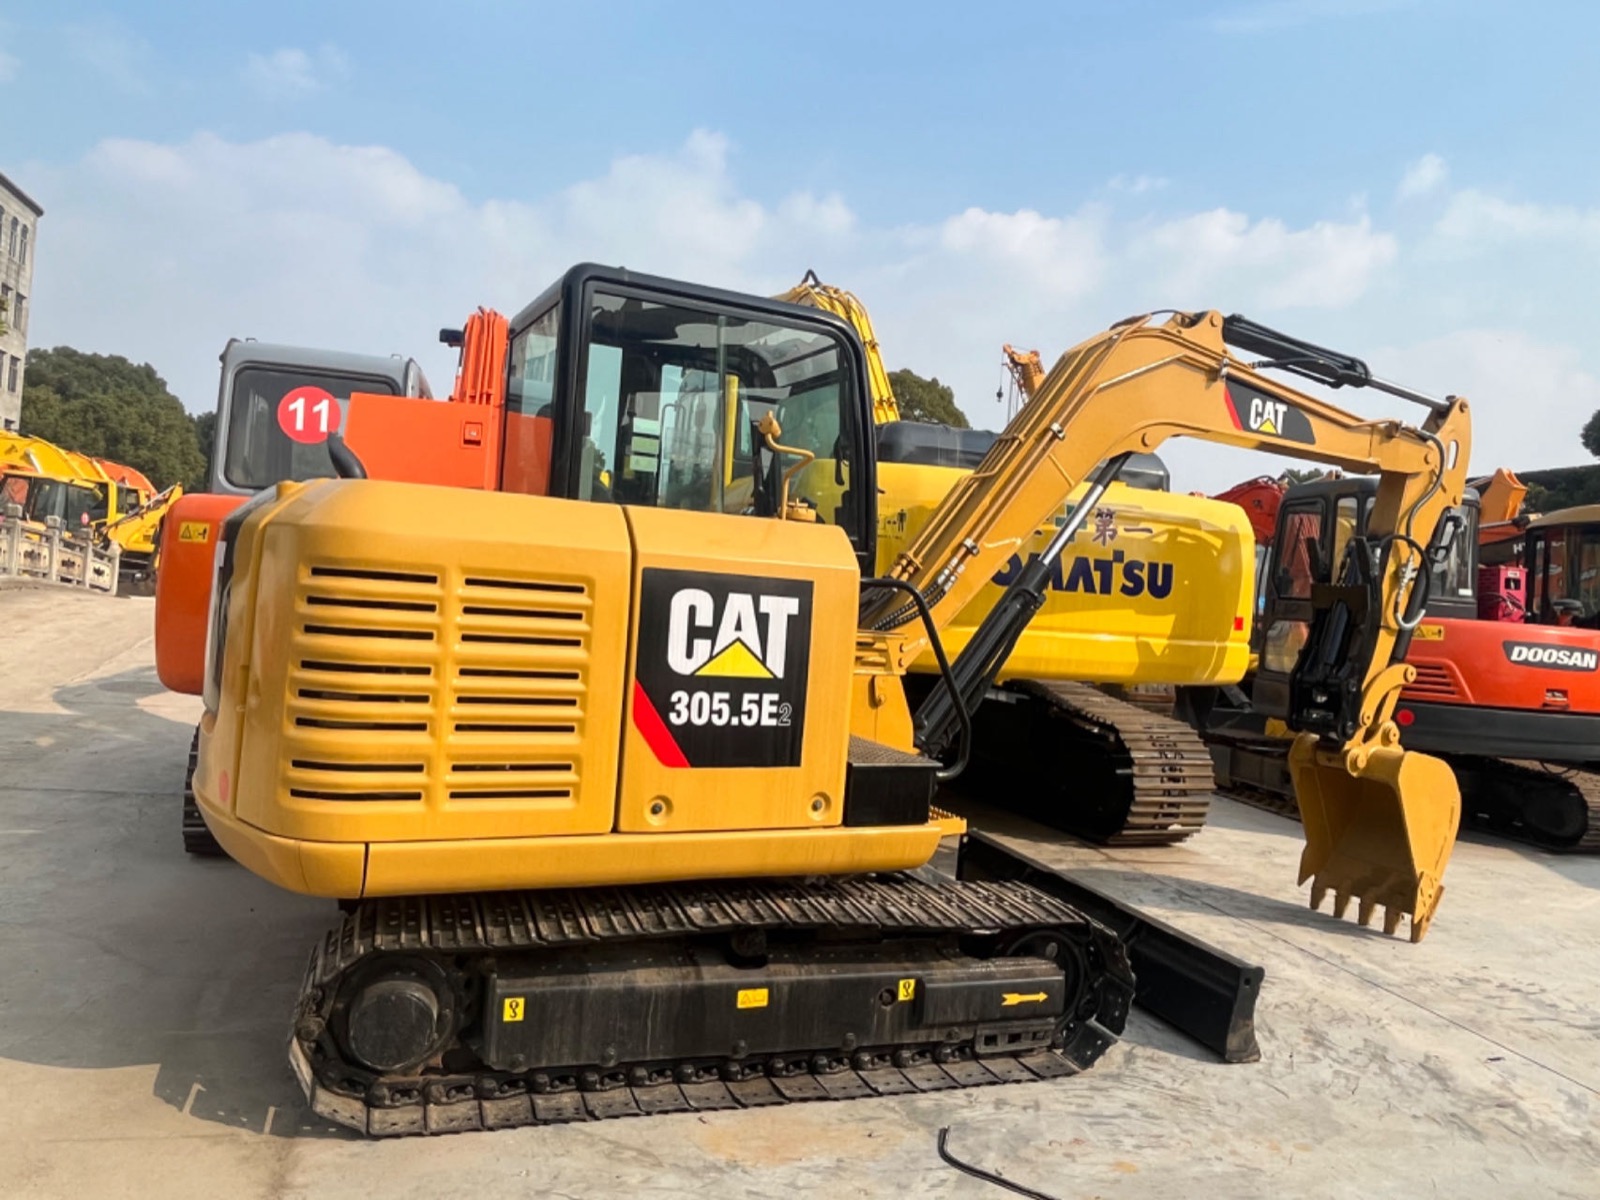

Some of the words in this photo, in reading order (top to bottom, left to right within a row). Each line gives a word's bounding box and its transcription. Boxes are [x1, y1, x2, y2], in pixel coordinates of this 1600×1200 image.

[289, 397, 329, 432] 11
[1250, 398, 1288, 435] CAT
[1093, 508, 1153, 546] 第一
[991, 549, 1173, 599] OMATSU
[668, 588, 799, 679] CAT
[1510, 646, 1597, 669] DOOSAN
